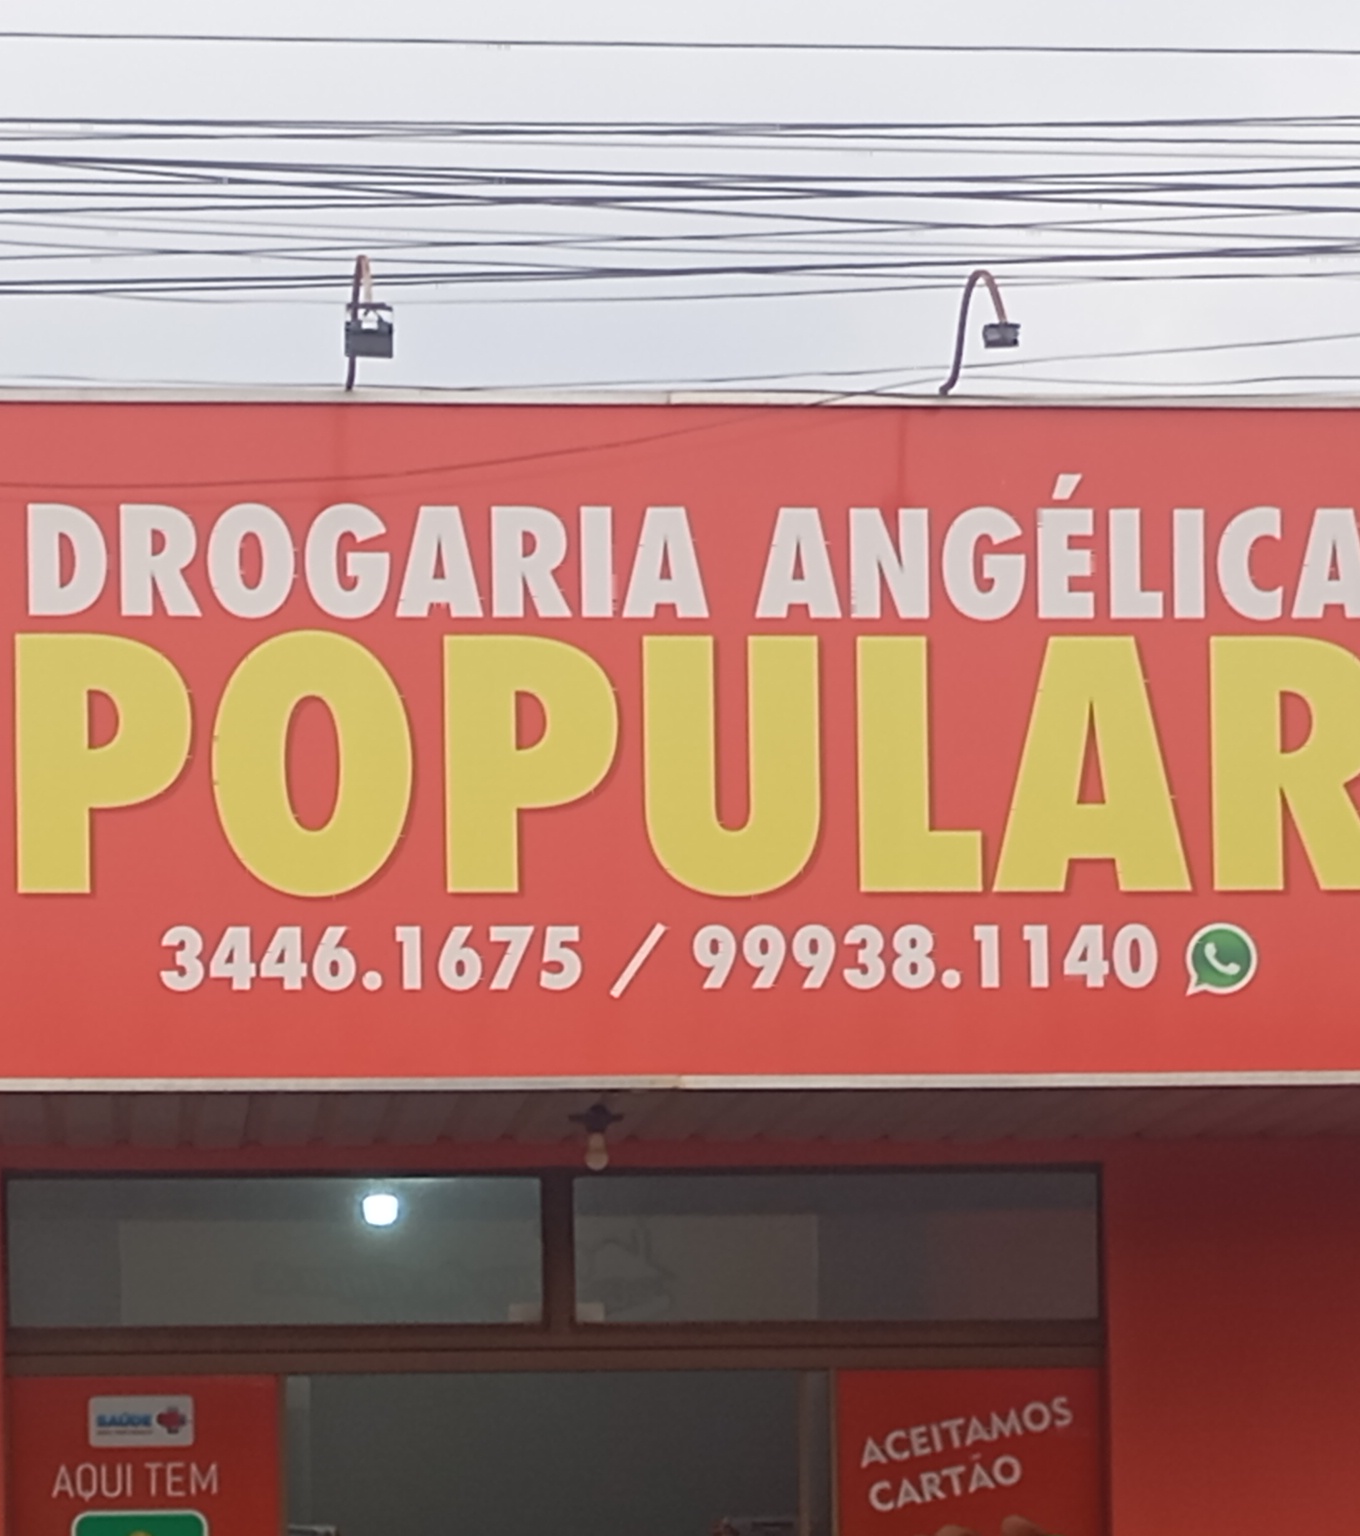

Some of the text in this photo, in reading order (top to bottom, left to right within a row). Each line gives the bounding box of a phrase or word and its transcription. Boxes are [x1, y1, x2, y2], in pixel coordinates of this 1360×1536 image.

[27, 502, 710, 620] DROGARIA
[159, 924, 583, 992] 3446.1675
[691, 923, 1158, 991] 99938.1140
[860, 1396, 1074, 1468] ACEITAMOS
[51, 1461, 219, 1501] AQUI TEM
[868, 1452, 1022, 1512] CARTÃO
